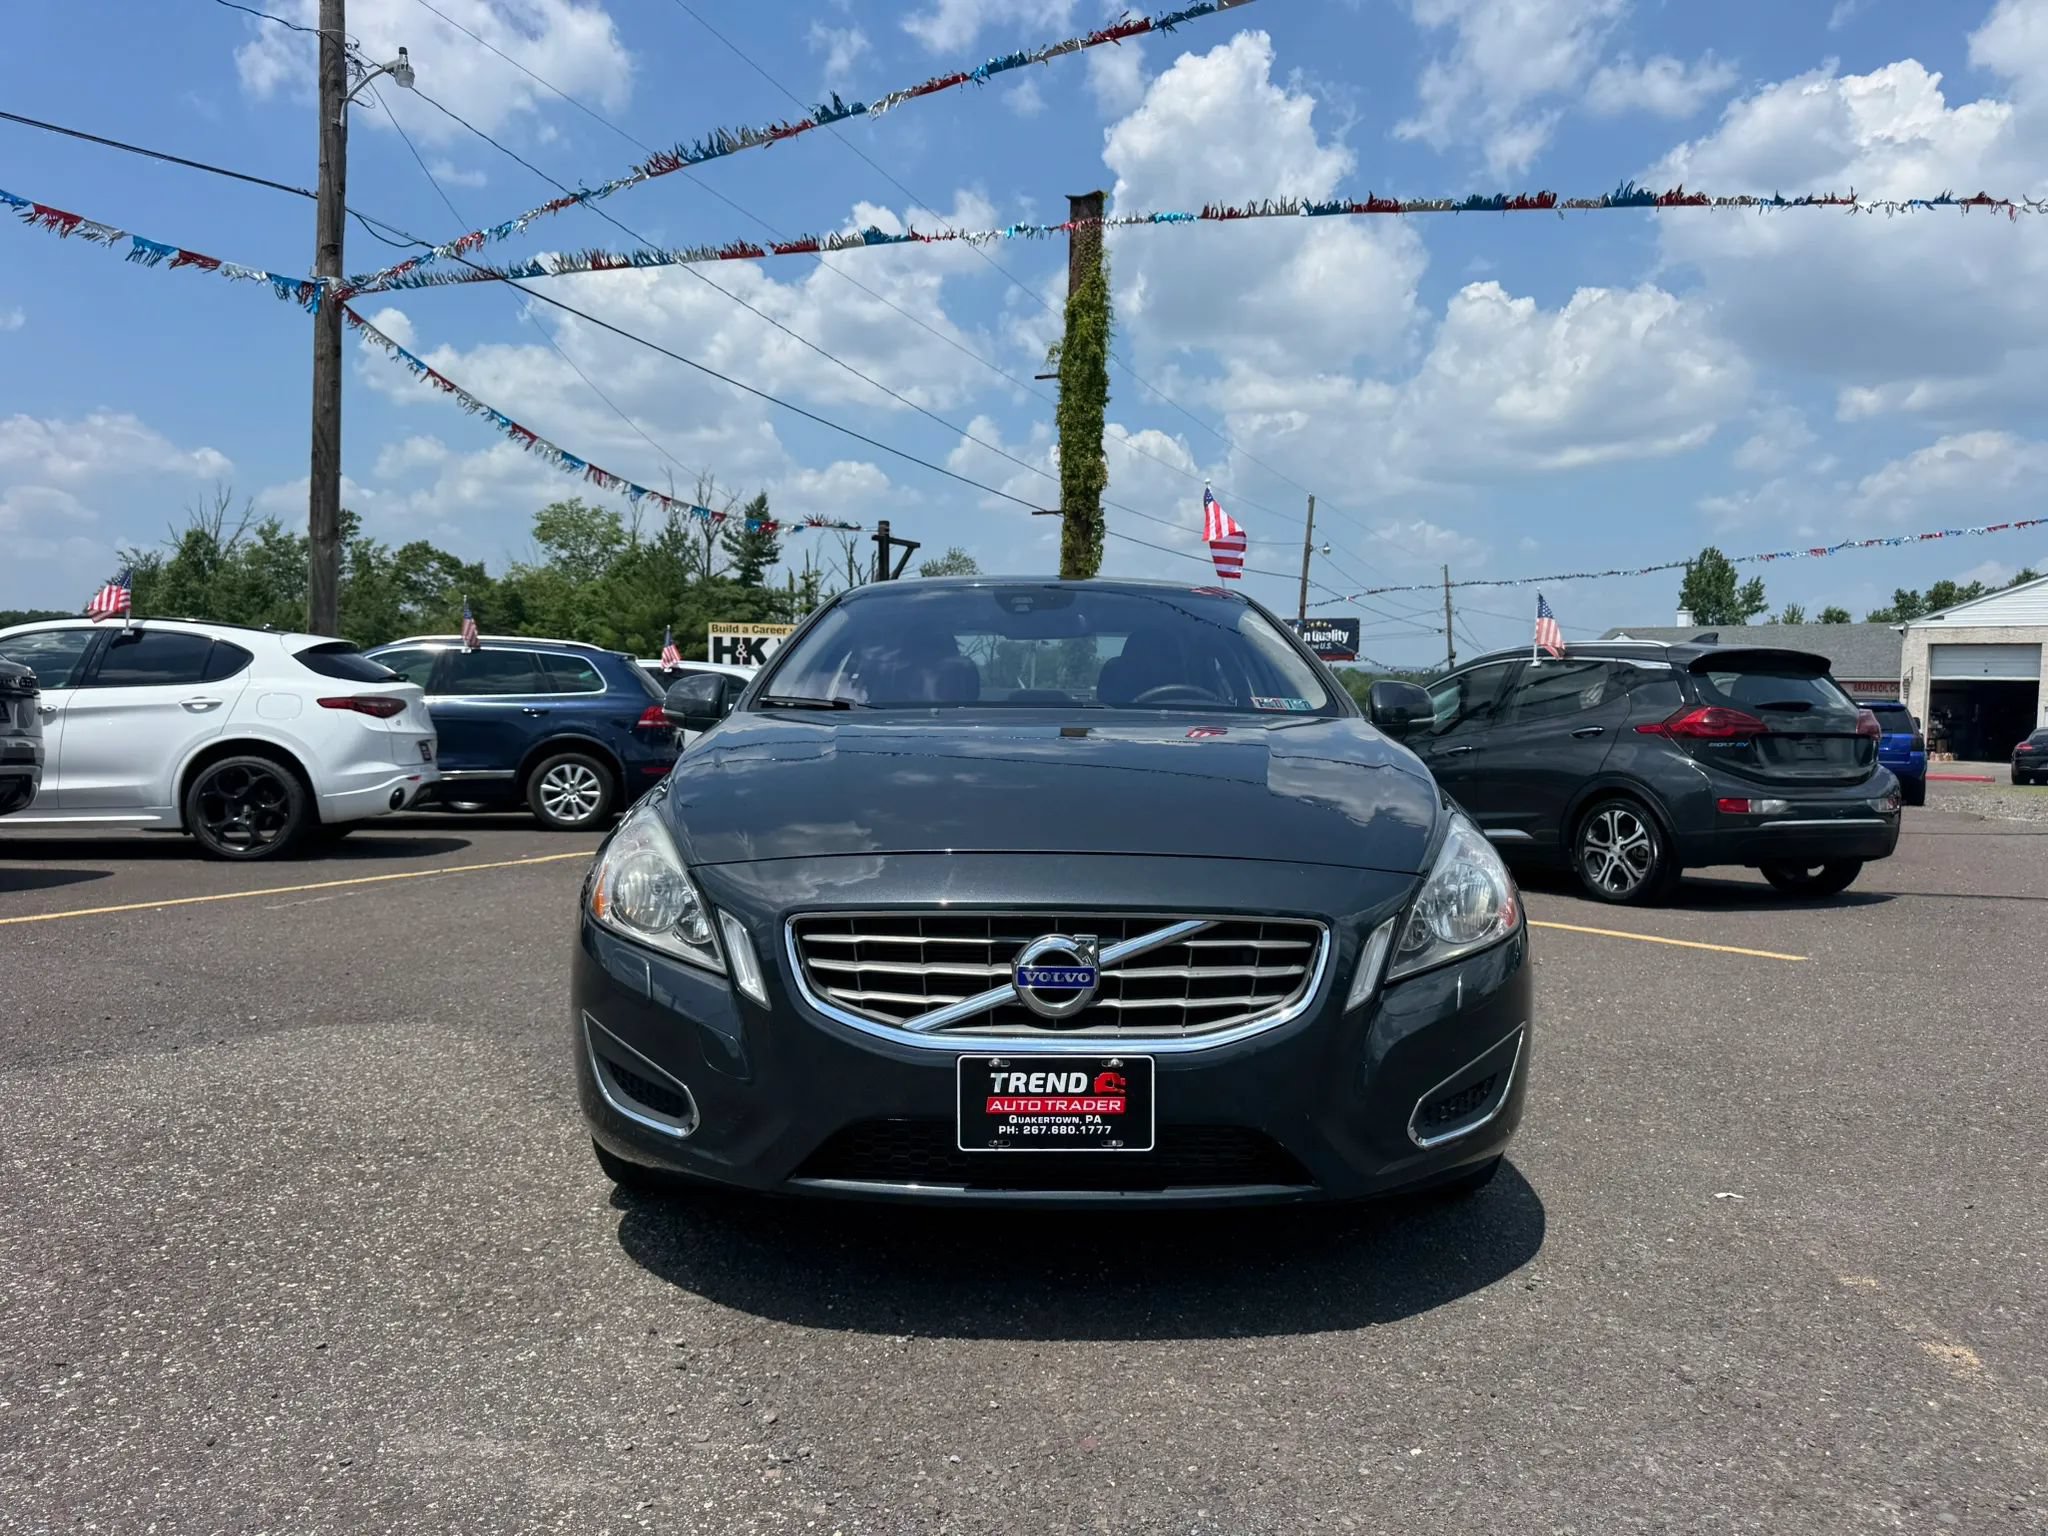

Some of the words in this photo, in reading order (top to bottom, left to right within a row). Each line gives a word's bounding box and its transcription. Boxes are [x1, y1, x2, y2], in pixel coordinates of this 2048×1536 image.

[711, 623, 739, 633] Build
[751, 625, 787, 634] Career
[1311, 629, 1349, 644] Quality
[713, 636, 770, 666] H&K
[1022, 971, 1091, 983] VOLVO
[990, 1072, 1088, 1094] TREND
[989, 1100, 1041, 1111] AUTO
[1044, 1100, 1121, 1111] TRADER
[1085, 1115, 1102, 1124] PA
[998, 1126, 1019, 1135] PH:
[1023, 1126, 1112, 1135] 267.680.1777
